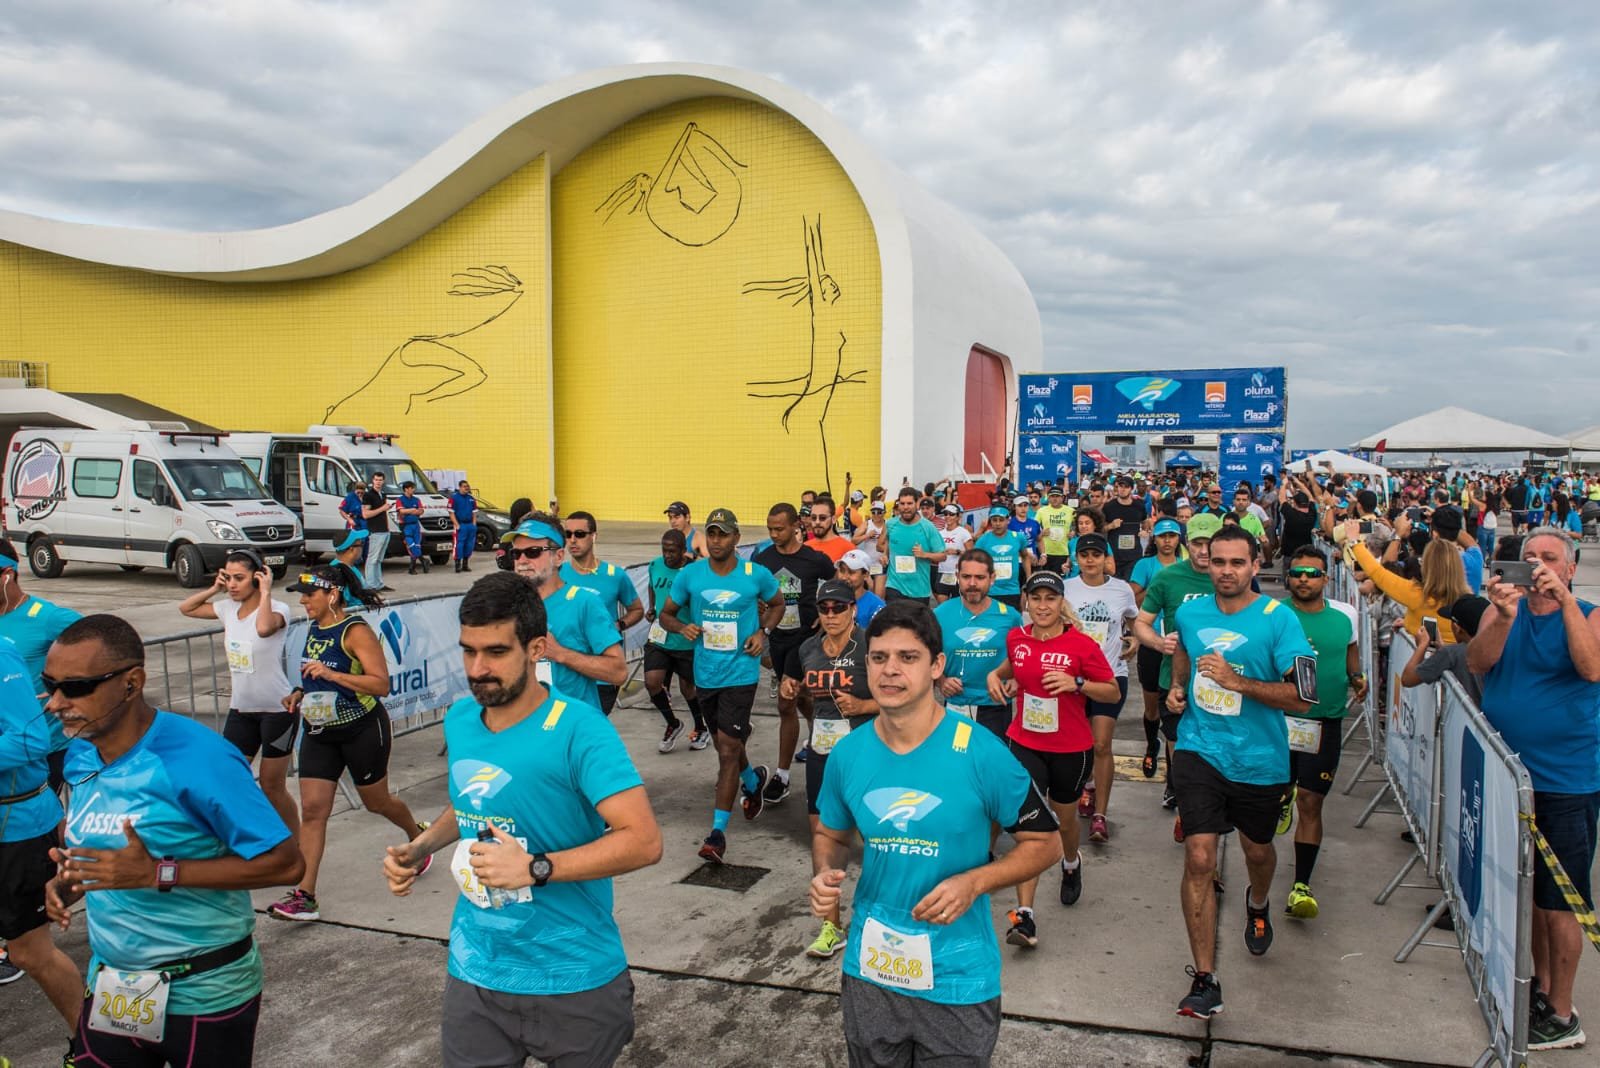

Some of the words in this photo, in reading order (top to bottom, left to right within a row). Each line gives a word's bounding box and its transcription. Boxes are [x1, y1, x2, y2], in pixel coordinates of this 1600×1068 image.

[1027, 385, 1051, 397] Plaza
[1244, 385, 1274, 397] plural
[1244, 409, 1270, 420] Plaza
[1028, 416, 1054, 427] plural
[1125, 418, 1180, 426] NITERÓI
[1255, 444, 1274, 454] Plaza
[1290, 730, 1315, 746] 753
[80, 812, 142, 835] ASSIST
[458, 817, 516, 833] NITEÓI
[887, 837, 939, 848] MARATONA
[866, 946, 923, 979] 2268
[878, 972, 910, 985] MARCELO
[100, 992, 156, 1025] 2045
[111, 1020, 138, 1033] MARCUS
